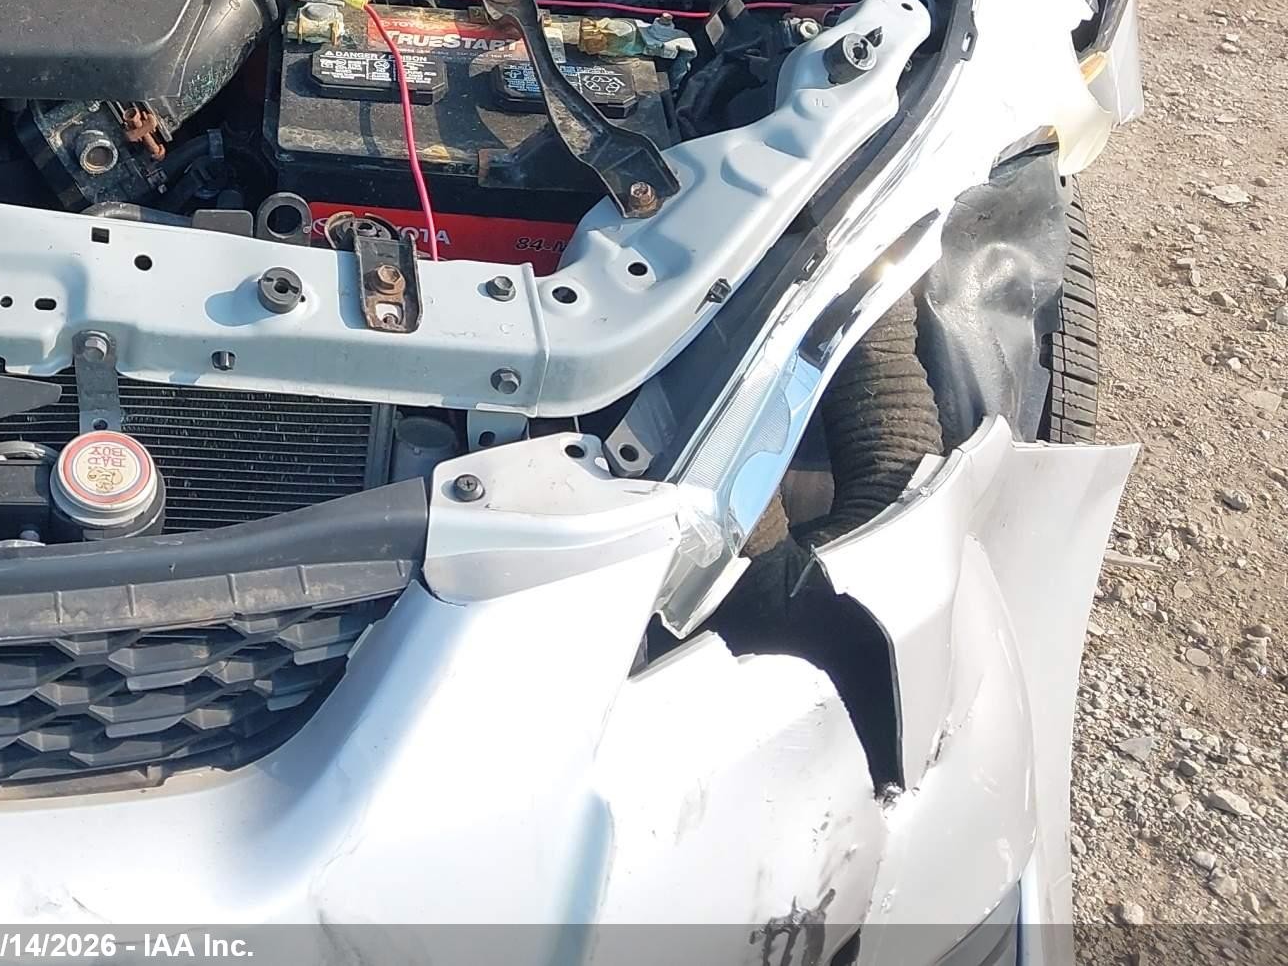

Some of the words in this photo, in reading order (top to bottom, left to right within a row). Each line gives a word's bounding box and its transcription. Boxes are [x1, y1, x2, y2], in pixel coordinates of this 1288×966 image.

[335, 50, 378, 60] DANGER
[388, 54, 428, 63] PISON
[88, 446, 127, 457] BOY
[87, 456, 127, 468] BAD
